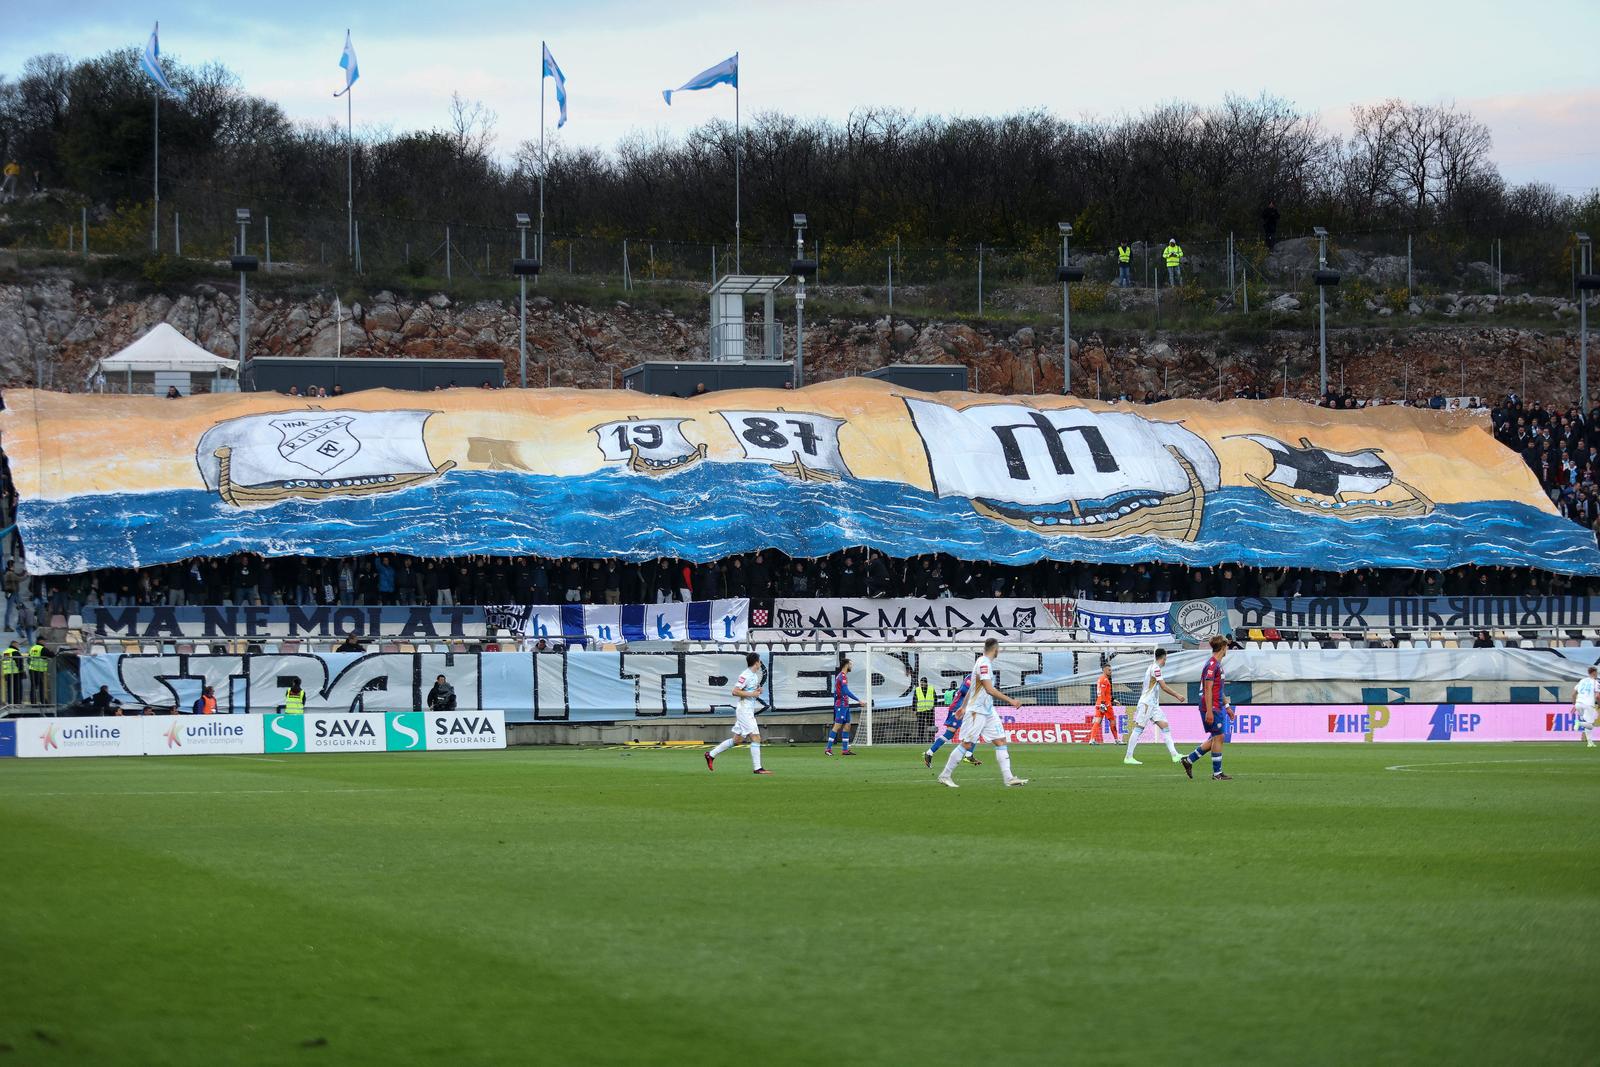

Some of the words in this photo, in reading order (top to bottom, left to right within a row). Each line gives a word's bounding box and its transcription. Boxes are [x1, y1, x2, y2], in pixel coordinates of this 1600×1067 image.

[282, 421, 309, 429] HNK
[611, 424, 664, 452] 19
[742, 417, 823, 456] 87
[201, 606, 271, 637] NE
[808, 605, 1009, 638] ARMADA
[1079, 613, 1166, 634] ULTRAS
[63, 724, 121, 739] uniline
[186, 722, 244, 737] uniline
[315, 719, 376, 737] SAVA
[435, 717, 496, 735] SAVA
[1444, 713, 1481, 732] HEP
[209, 737, 244, 746] company
[316, 738, 377, 746] OSIGURANJE
[436, 736, 497, 744] OSIGURANJE
[1004, 723, 1073, 743] rcash
[86, 739, 121, 748] company
